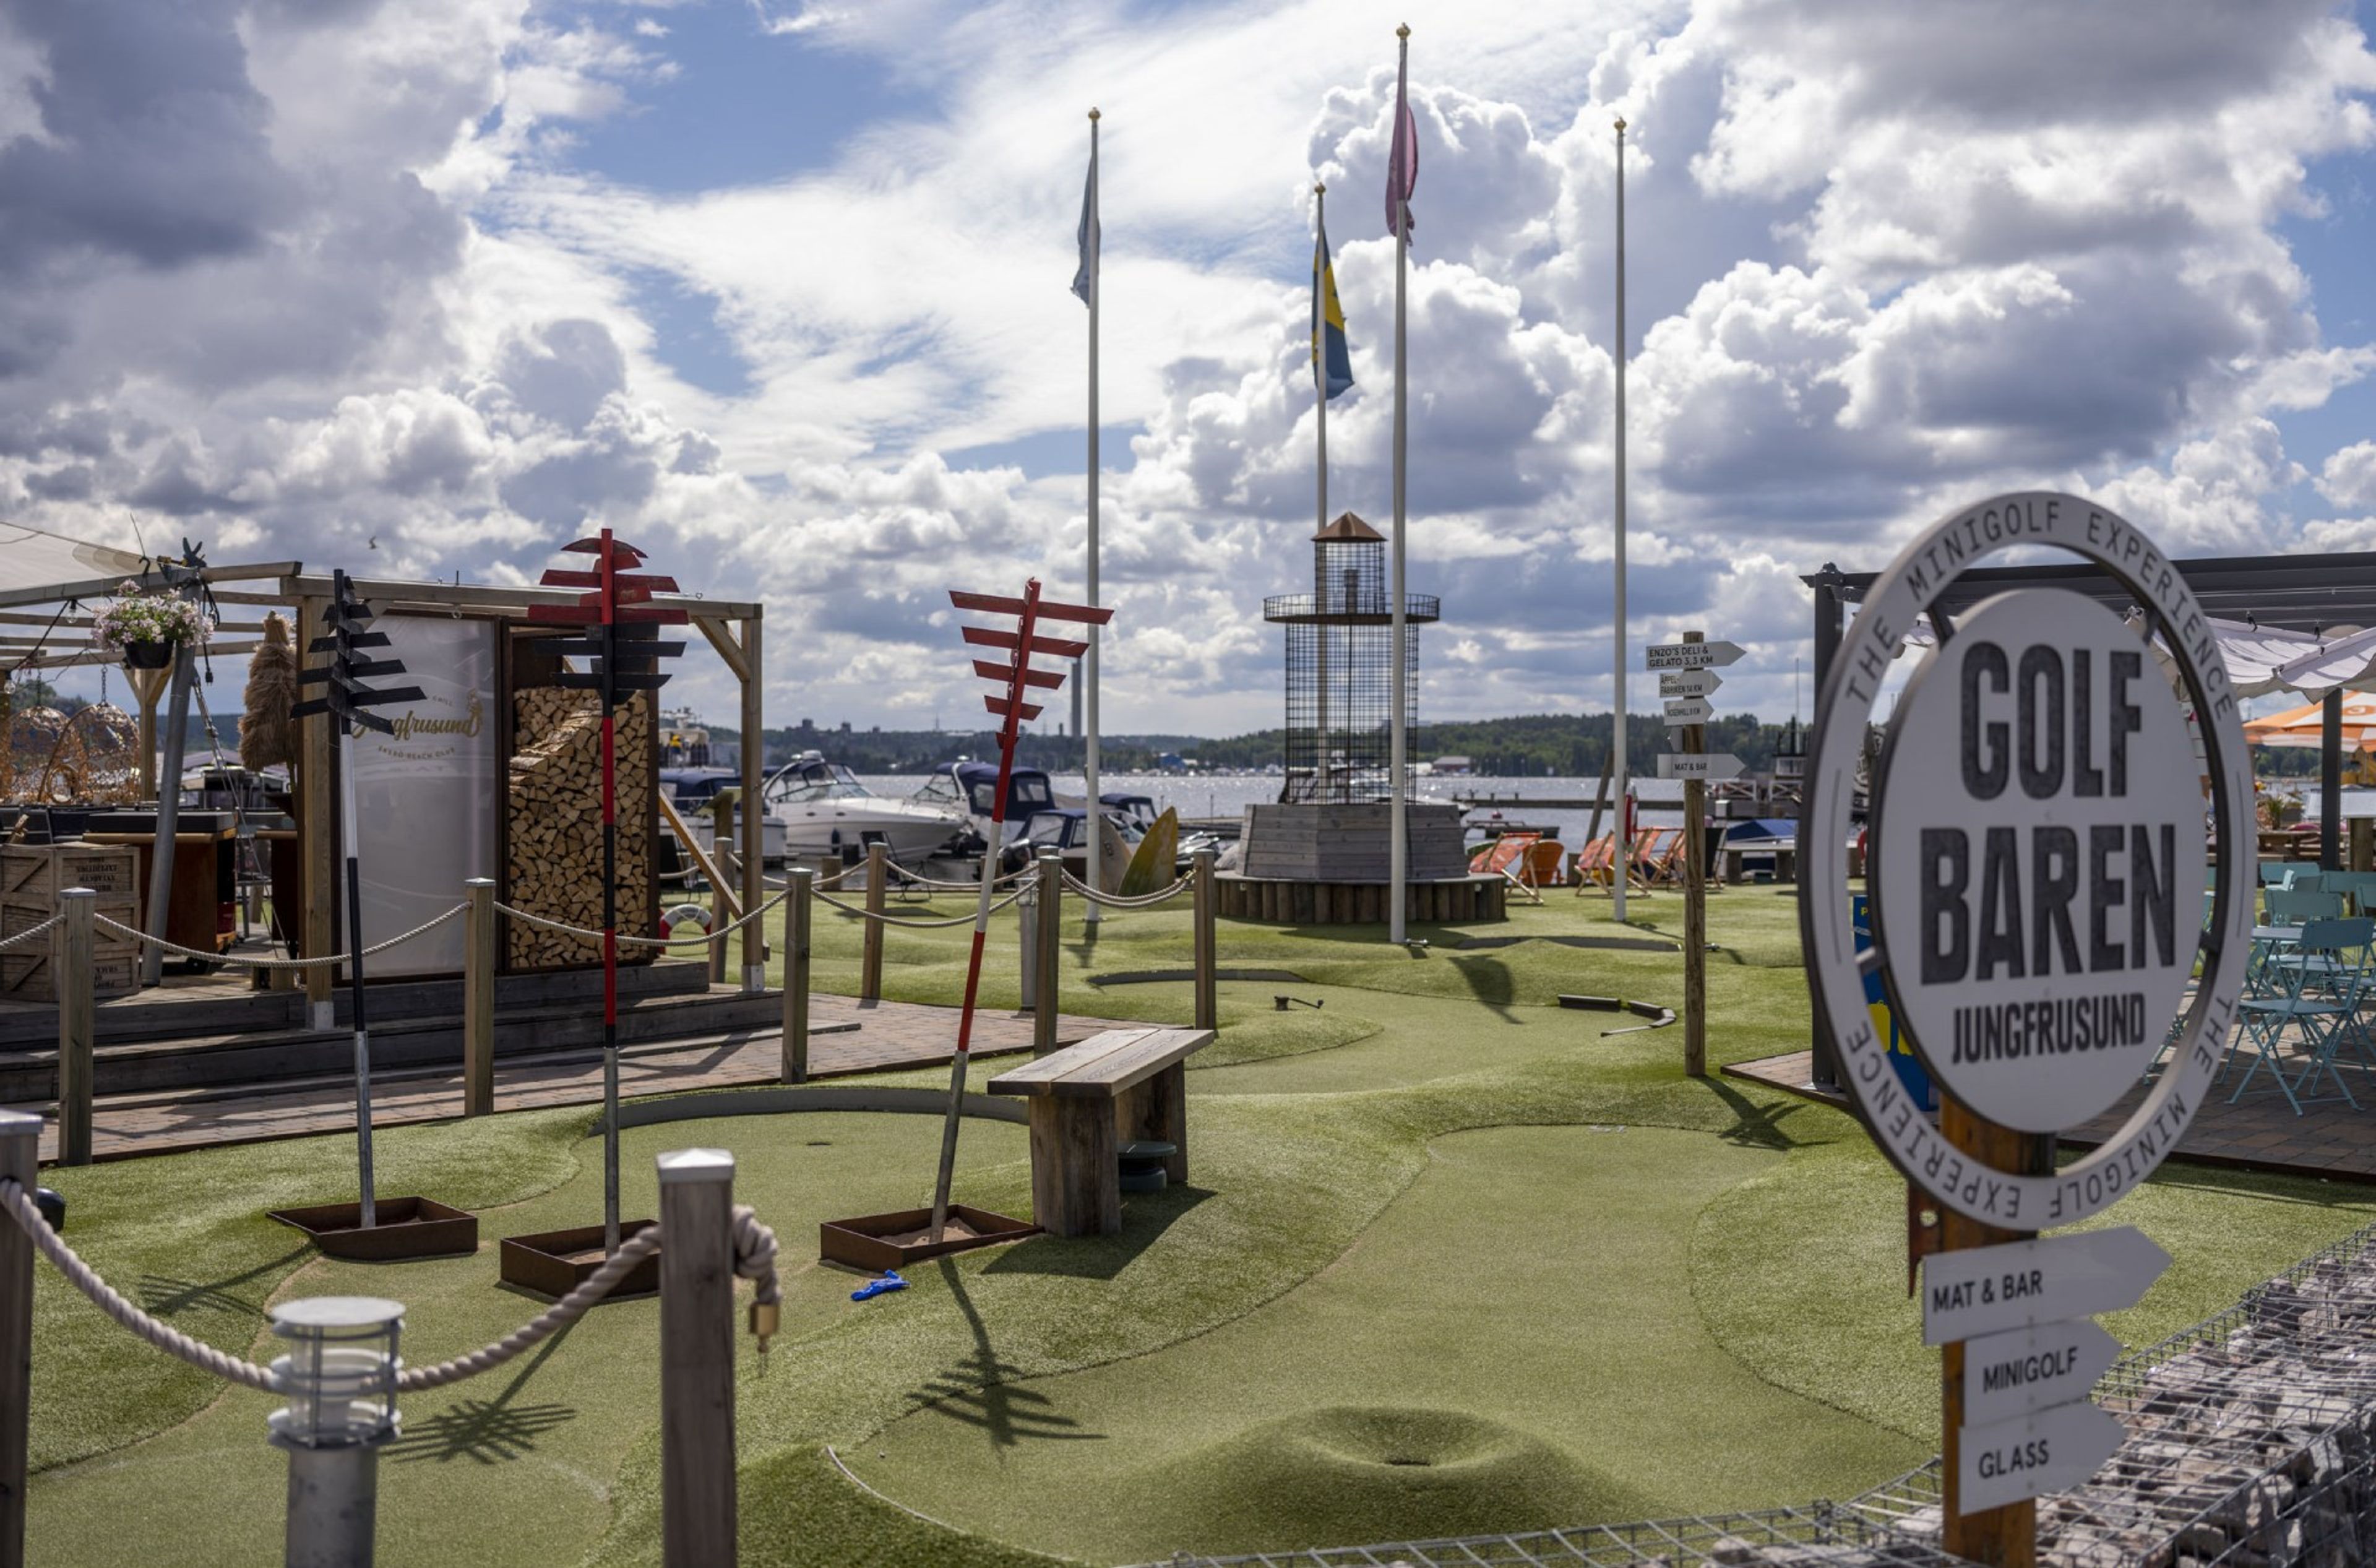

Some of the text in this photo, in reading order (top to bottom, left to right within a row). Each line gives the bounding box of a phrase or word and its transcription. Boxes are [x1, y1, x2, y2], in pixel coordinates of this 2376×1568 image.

[1845, 501, 2234, 723] THE MINIGOLF EXPERIENCE
[1650, 658, 1682, 667] GELATO
[1700, 656, 1713, 664] KM
[1682, 646, 1700, 655] DELI
[1702, 646, 1708, 654] &
[1694, 684, 1702, 692] KM
[1960, 641, 2143, 801] GOLF
[1920, 824, 2176, 986] BAREN
[1952, 993, 2146, 1065] JUNGFRUSUND
[1846, 996, 2234, 1220] THE MINIGOLF EXPERIENCE
[1932, 1269, 2043, 1312] MAT & BAR
[1982, 1346, 2079, 1394] MINIGOLF
[1978, 1439, 2050, 1480] GLASS
